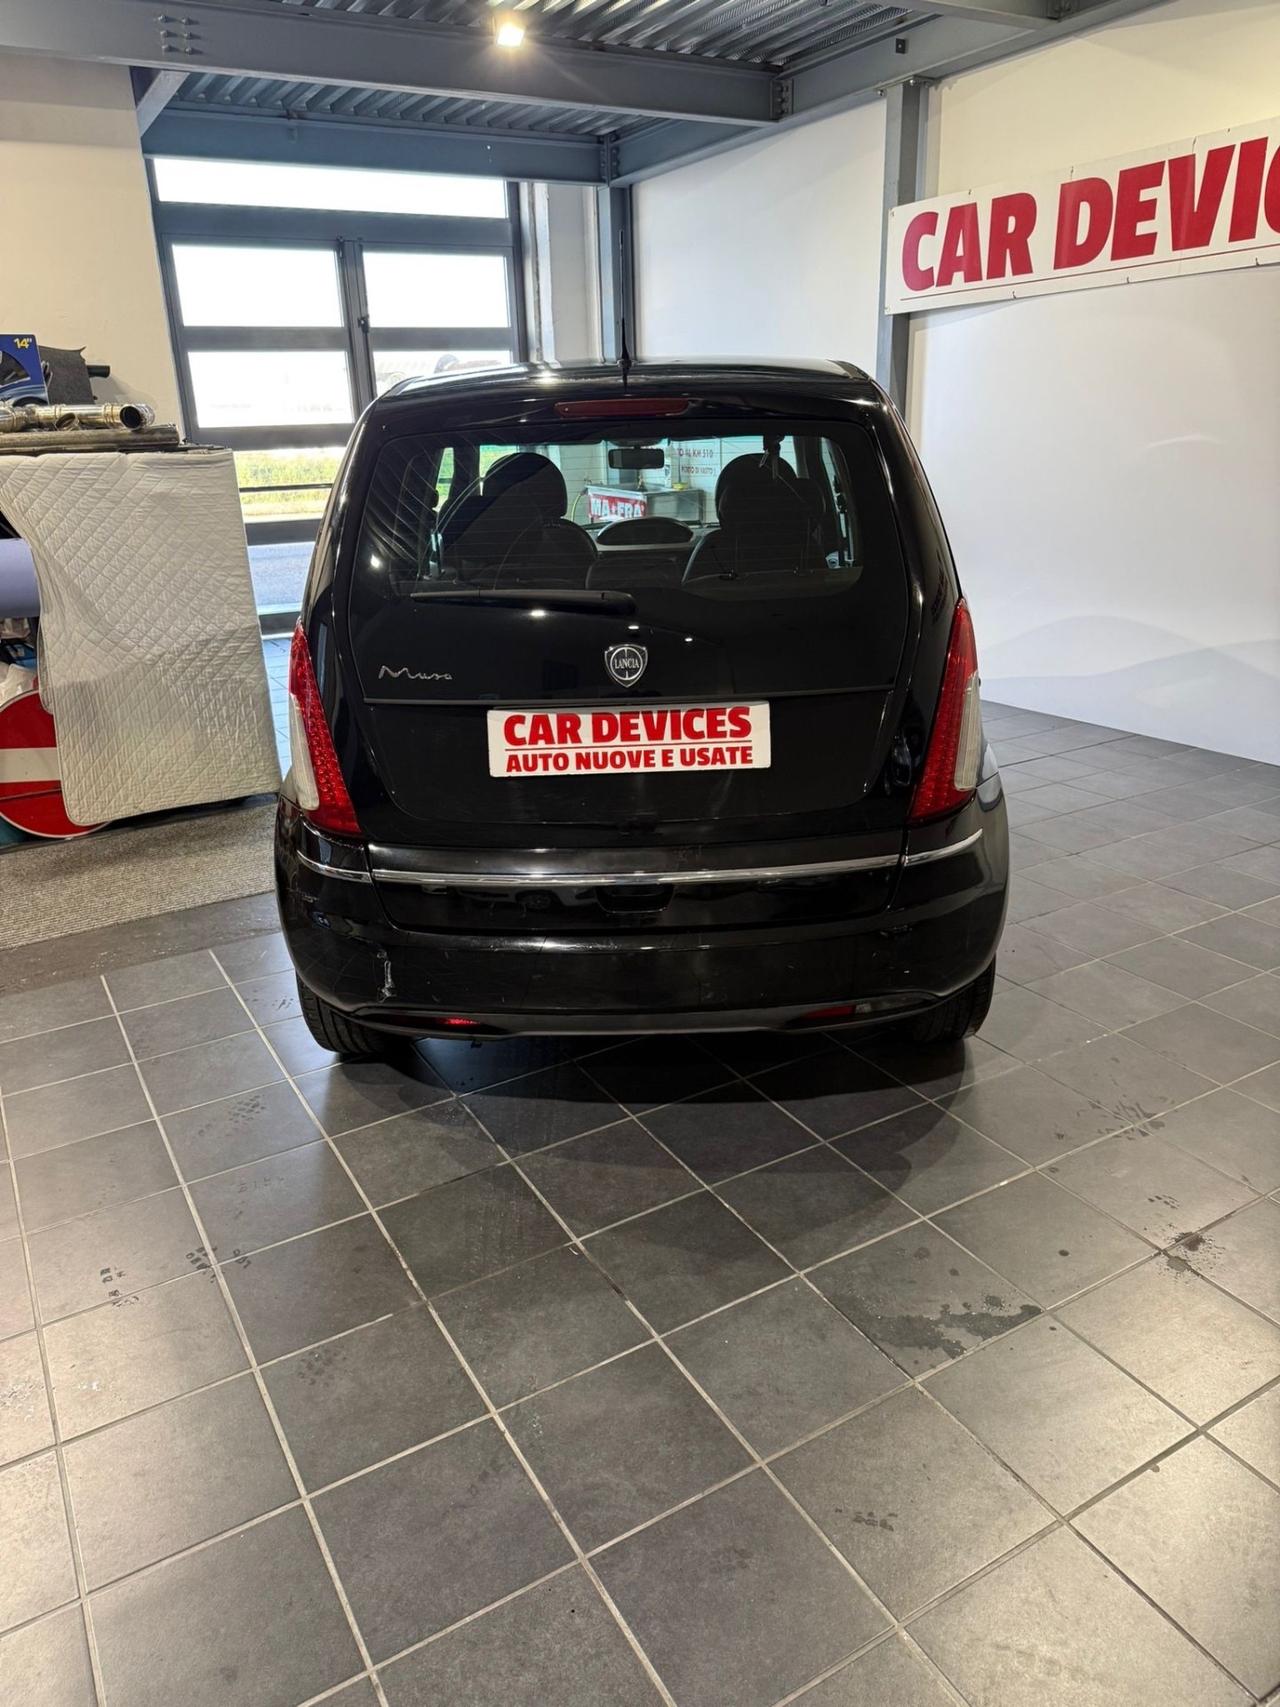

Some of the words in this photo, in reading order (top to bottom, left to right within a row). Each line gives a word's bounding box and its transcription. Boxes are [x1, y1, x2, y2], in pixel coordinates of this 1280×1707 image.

[902, 192, 1037, 292] CAR
[614, 658, 640, 669] LANCIA
[504, 712, 581, 746] CAR
[592, 706, 752, 743] DEVICES
[506, 752, 570, 772] AUTO
[575, 749, 656, 770] NUOVE
[662, 749, 673, 767] E
[680, 746, 753, 766] USATE
